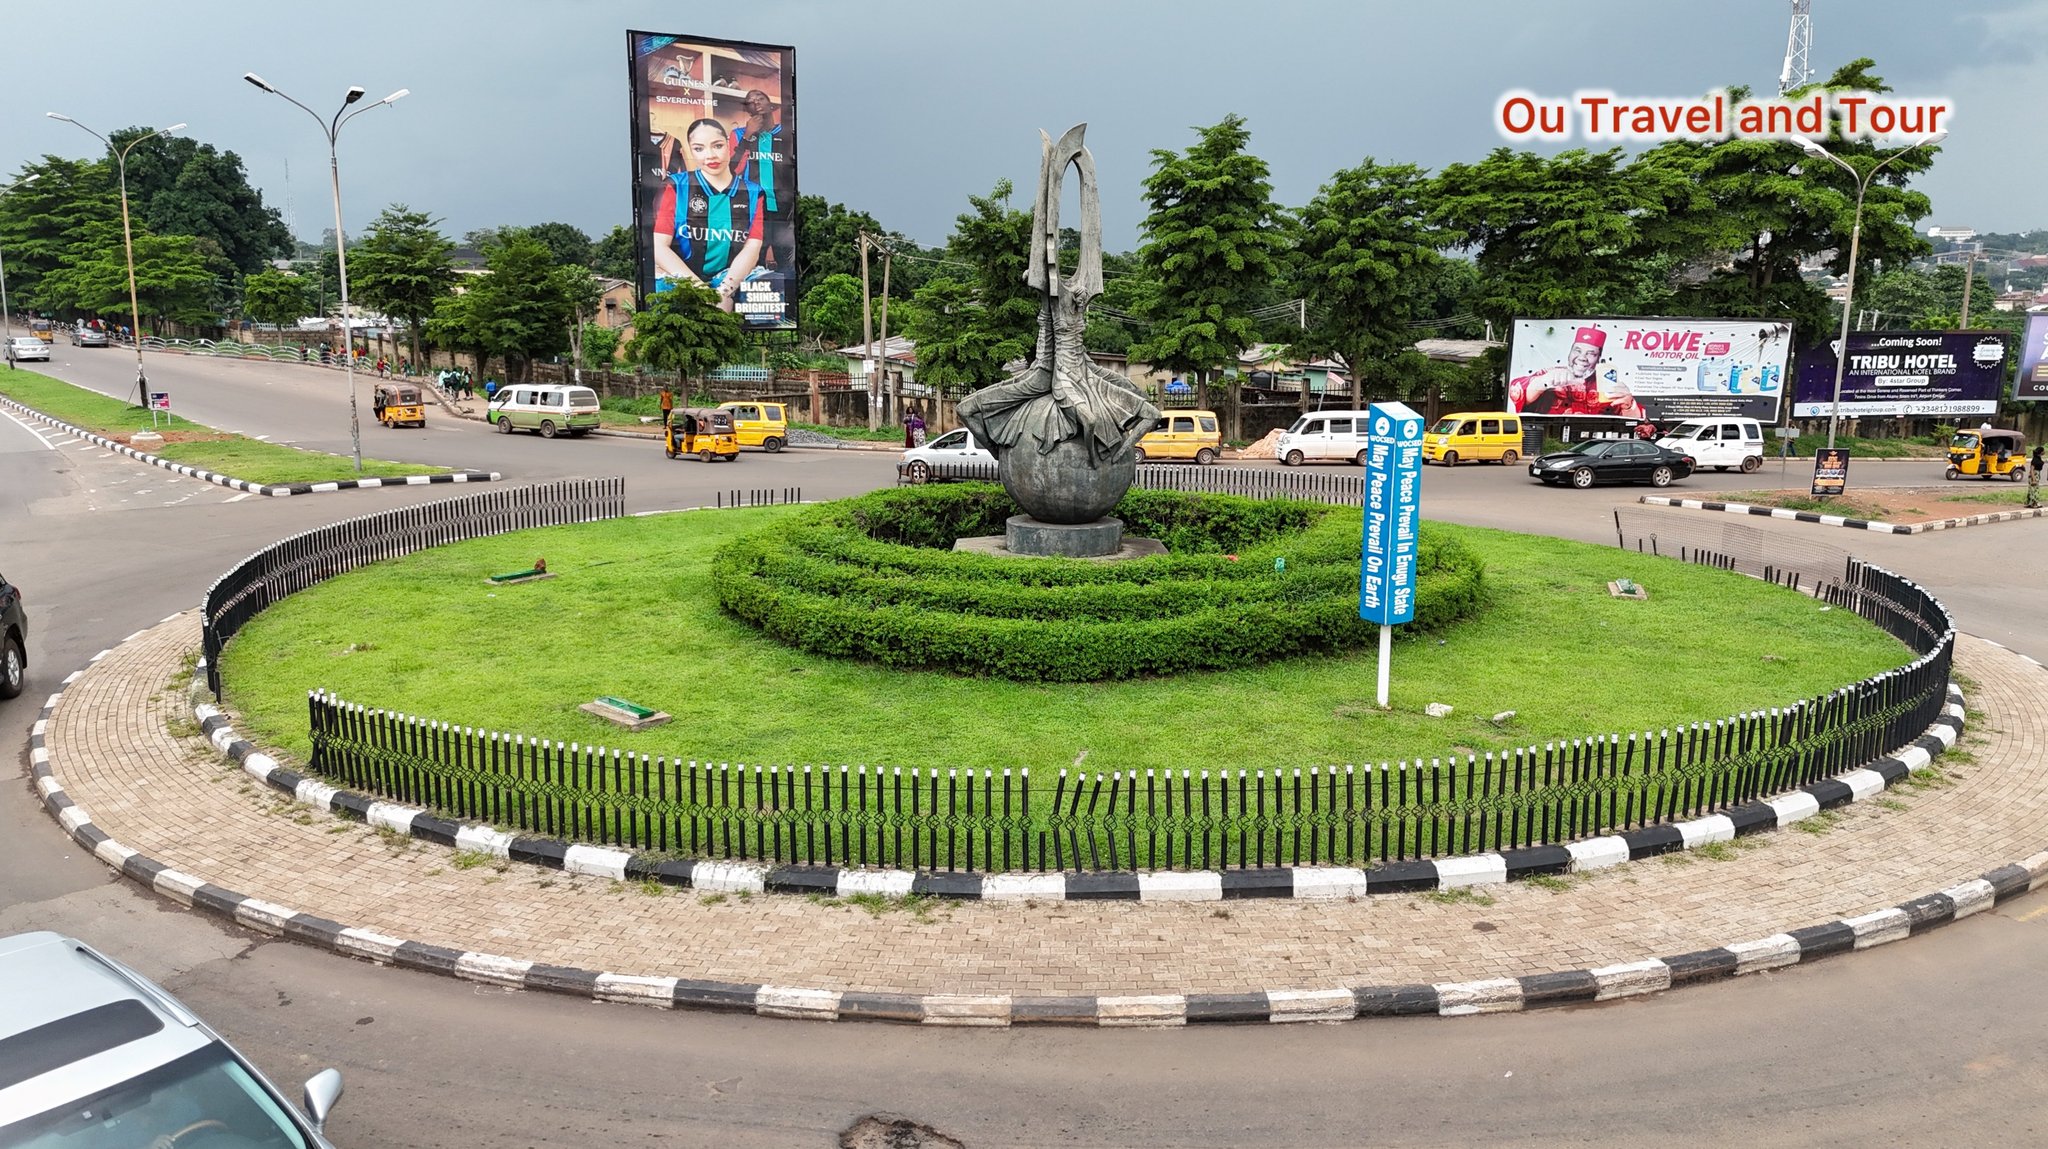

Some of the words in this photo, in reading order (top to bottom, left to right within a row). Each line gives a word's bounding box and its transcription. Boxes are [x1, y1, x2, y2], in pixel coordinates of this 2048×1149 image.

[663, 76, 709, 88] GUINNESS
[656, 95, 718, 107] SEVERENATURE
[678, 224, 750, 243] GUINNES
[740, 281, 772, 292] BLACK
[746, 292, 781, 303] SHINES
[735, 302, 786, 313] BRIGHTEST
[1624, 330, 1704, 352] ROWE
[1915, 337, 1942, 347] Soon!
[1649, 351, 1683, 360] MOTOR
[1685, 352, 1700, 360] OIL
[1850, 354, 1900, 369] TRIBU
[1904, 354, 1957, 369] HOTEL
[1368, 444, 1389, 470] May
[1398, 447, 1419, 469] May
[1369, 472, 1387, 510] Peace
[1400, 471, 1417, 503] Peace
[1397, 505, 1416, 540] Prevail
[1367, 512, 1385, 554] Prevail
[1397, 542, 1414, 553] In
[1367, 556, 1383, 573] On
[1391, 554, 1413, 586] Enugu
[1365, 574, 1382, 609] Earth
[1393, 587, 1411, 615] State
